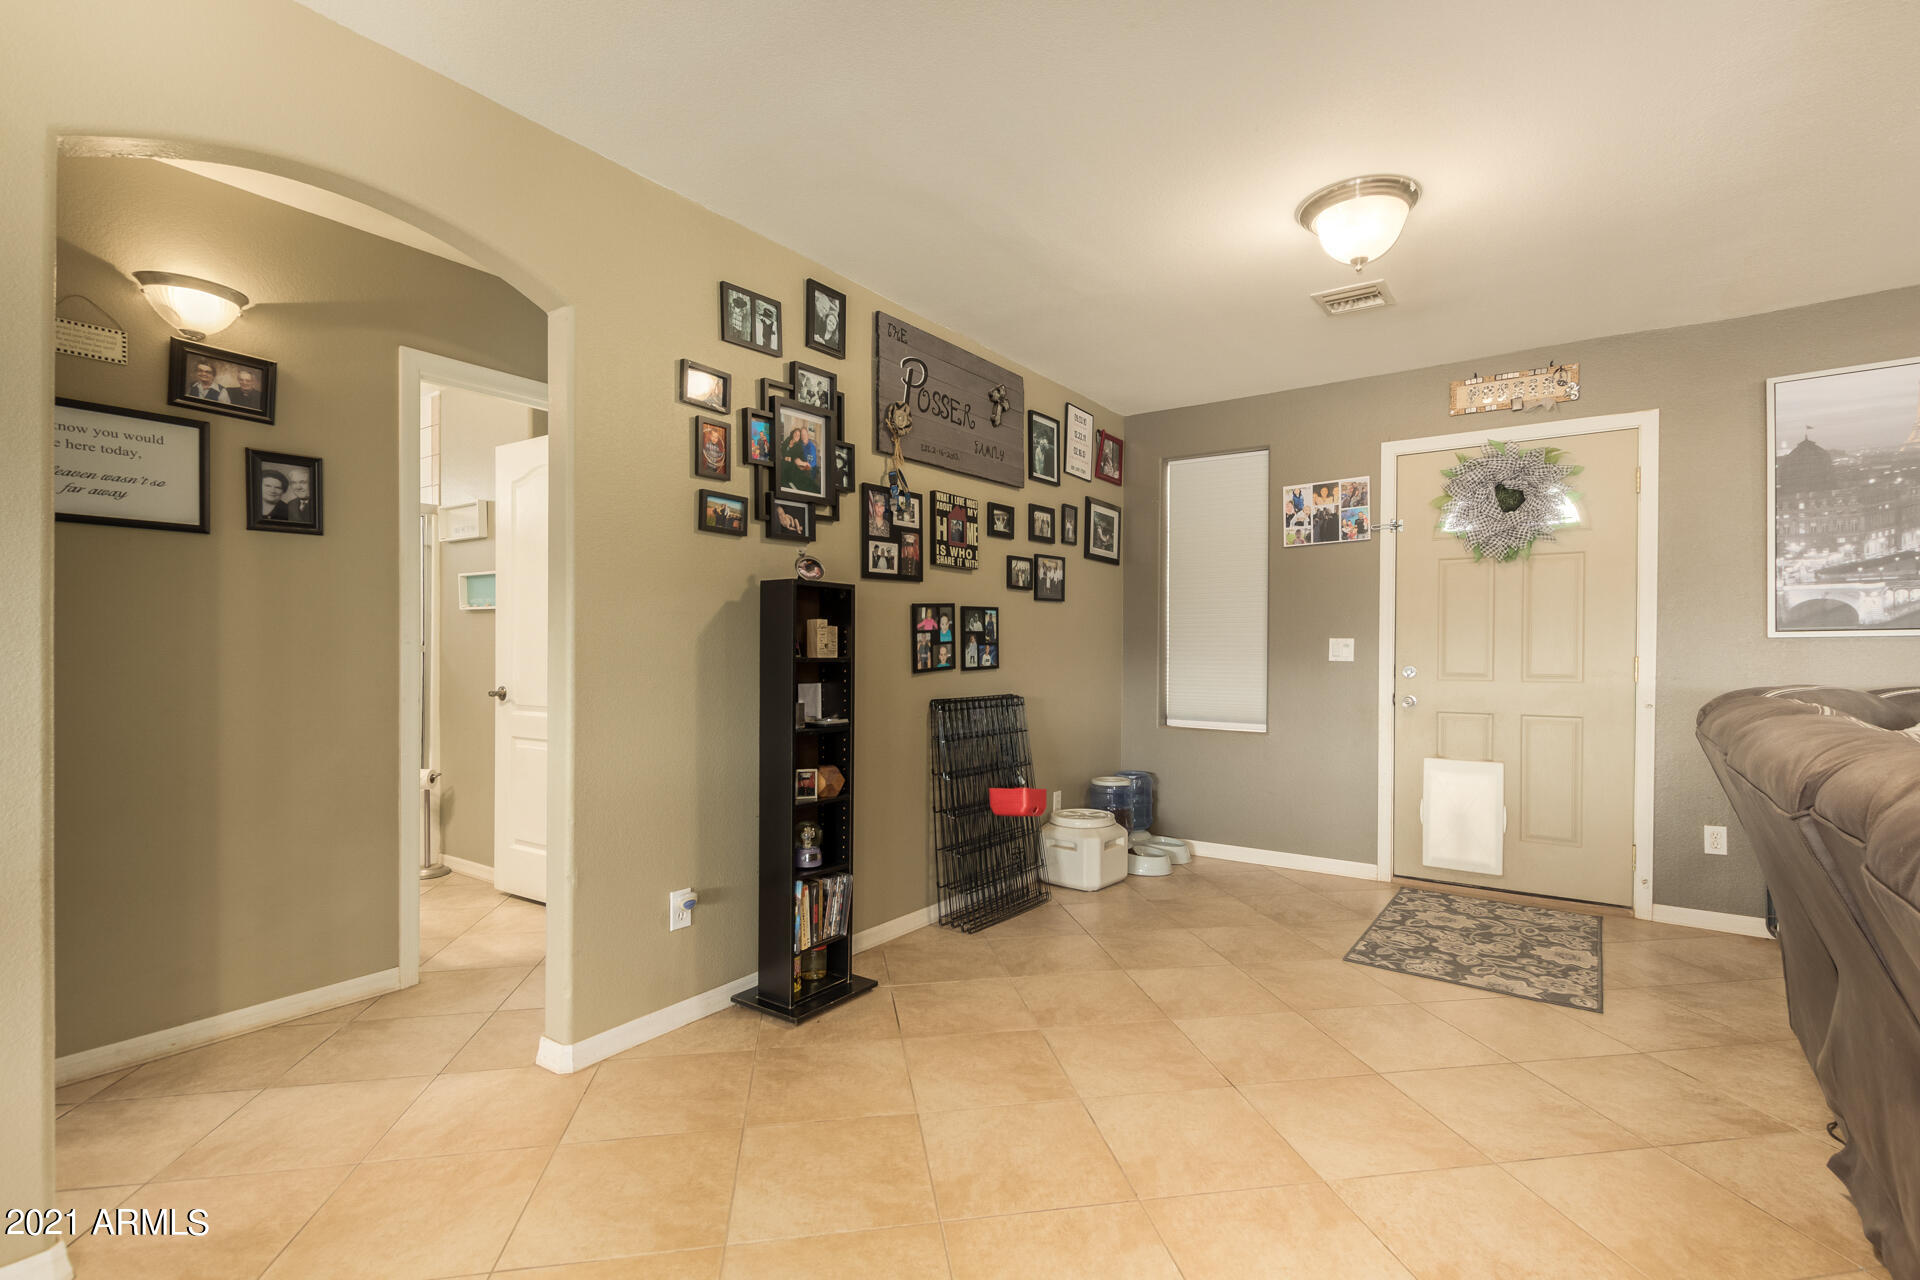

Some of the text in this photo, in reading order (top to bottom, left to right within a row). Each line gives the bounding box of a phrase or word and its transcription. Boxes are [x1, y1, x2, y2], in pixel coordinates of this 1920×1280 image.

[887, 322, 908, 344] THE
[900, 356, 975, 430] POSSER
[54, 423, 164, 445] now you would
[65, 438, 96, 452] here
[100, 444, 142, 460] today,
[54, 465, 97, 480] eaven
[100, 473, 148, 486] wasn't
[56, 482, 129, 501] far away
[936, 492, 949, 504] WHAT
[955, 496, 965, 507] LOVE
[936, 501, 978, 518] ABOUT MY
[936, 543, 947, 555] IS
[949, 547, 973, 560] WHO
[936, 555, 979, 569] SHARE IT WITH
